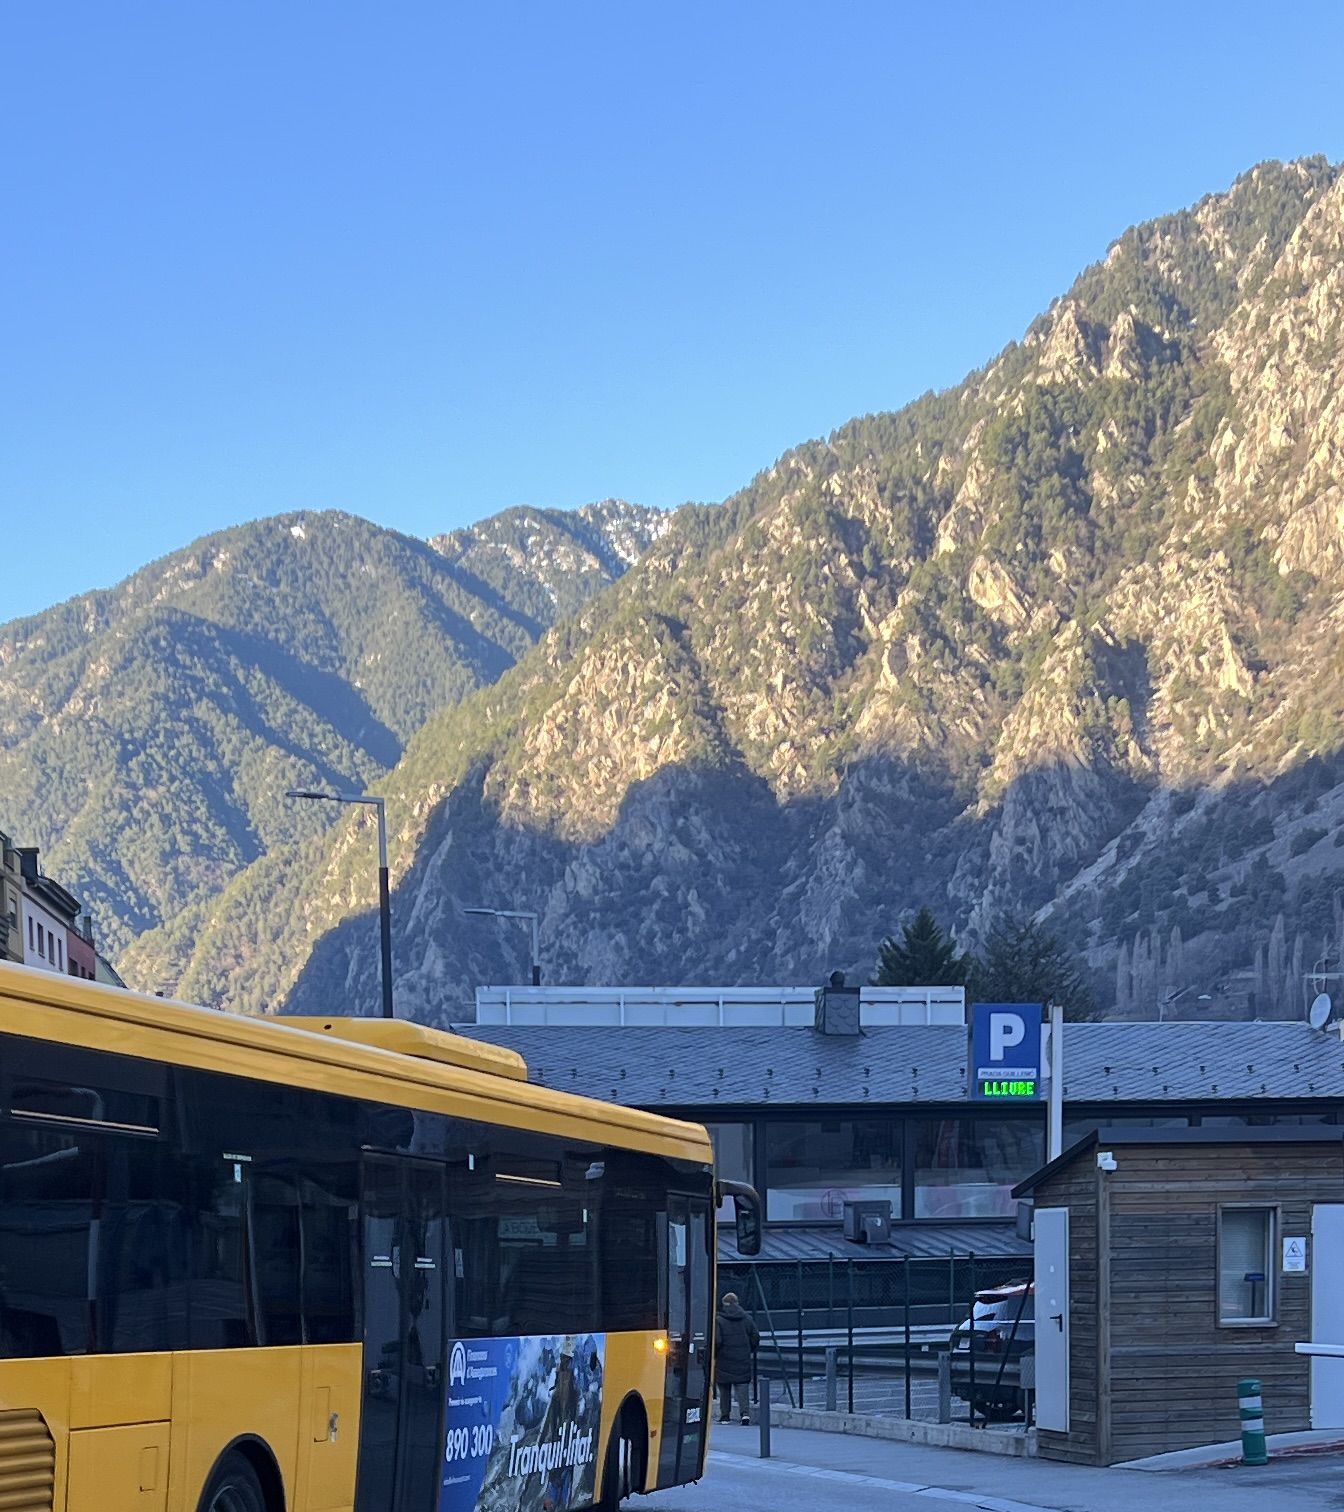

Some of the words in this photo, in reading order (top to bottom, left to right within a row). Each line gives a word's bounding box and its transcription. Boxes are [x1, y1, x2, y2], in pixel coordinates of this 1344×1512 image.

[990, 1013, 1025, 1060] P
[445, 1427, 469, 1462] 890
[470, 1424, 494, 1458] 300
